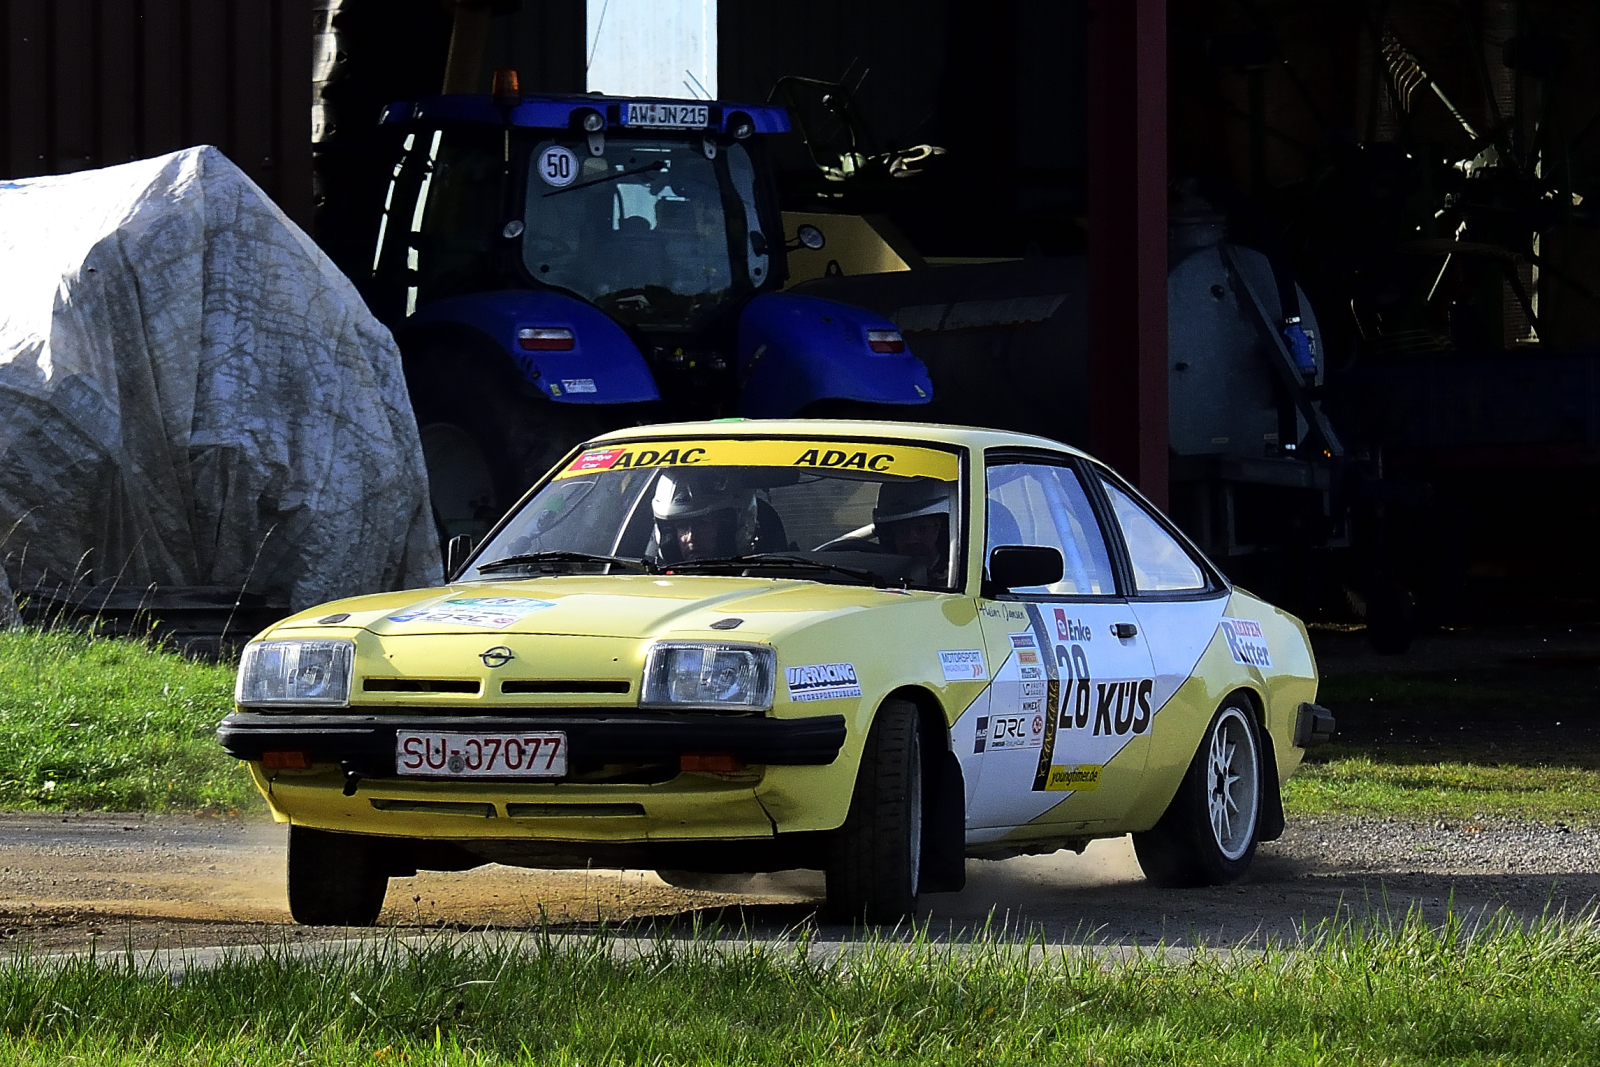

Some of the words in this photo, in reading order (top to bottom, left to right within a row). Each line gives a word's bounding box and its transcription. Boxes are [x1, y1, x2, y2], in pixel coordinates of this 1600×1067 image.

[630, 106, 649, 123] AW
[658, 107, 677, 123] JN
[680, 107, 706, 124] 215
[547, 153, 570, 178] 50
[582, 454, 613, 463] Rallye
[609, 448, 706, 469] ADAC
[793, 449, 895, 471] ADAC
[1068, 619, 1092, 642] Enke
[1231, 620, 1262, 637] REIFEN
[1221, 621, 1270, 666] Ritter
[941, 651, 980, 663] MOTORSPORT
[1055, 644, 1091, 728] 28
[1093, 679, 1153, 736] KÜS
[994, 717, 1026, 739] DRC
[1050, 767, 1099, 786] youngtimer.de
